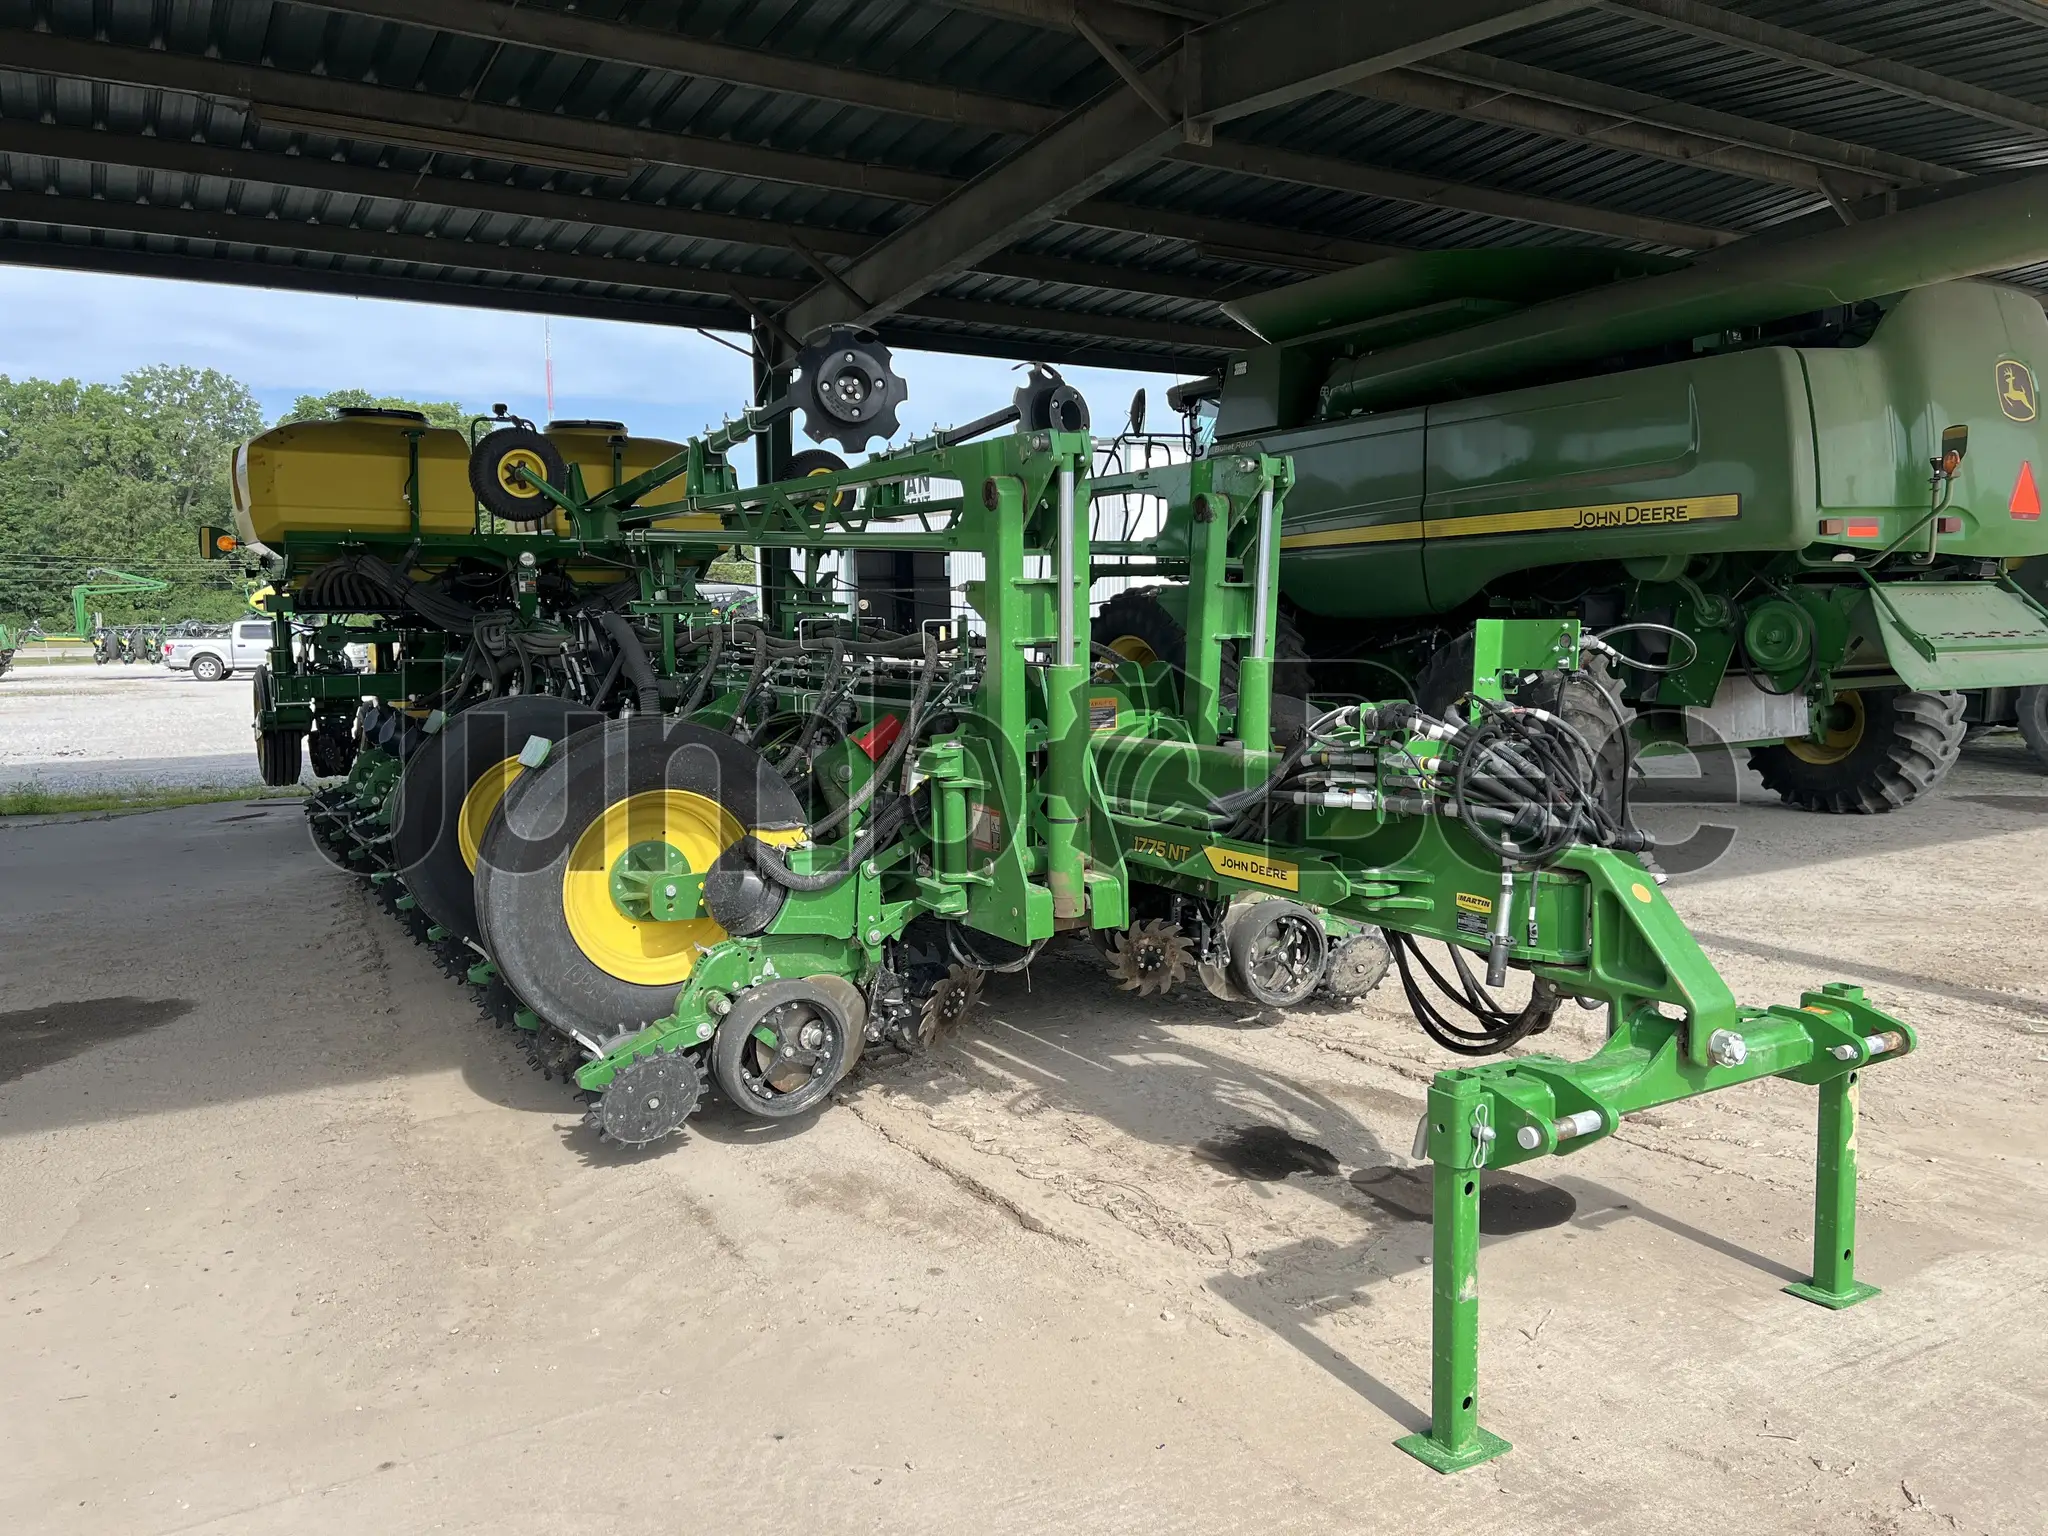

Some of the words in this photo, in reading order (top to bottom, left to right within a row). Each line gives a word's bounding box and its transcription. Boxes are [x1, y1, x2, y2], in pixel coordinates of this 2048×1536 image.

[1214, 443, 1234, 453] Bullet
[1235, 440, 1257, 449] Rotor
[1573, 510, 1621, 528] JOHN
[1625, 505, 1688, 523] DEERE
[1133, 835, 1166, 858] 1775
[1167, 842, 1191, 863] NT
[1220, 855, 1248, 873] JOHN
[1250, 861, 1288, 881] DEERE
[1459, 894, 1491, 908] MARTIN
